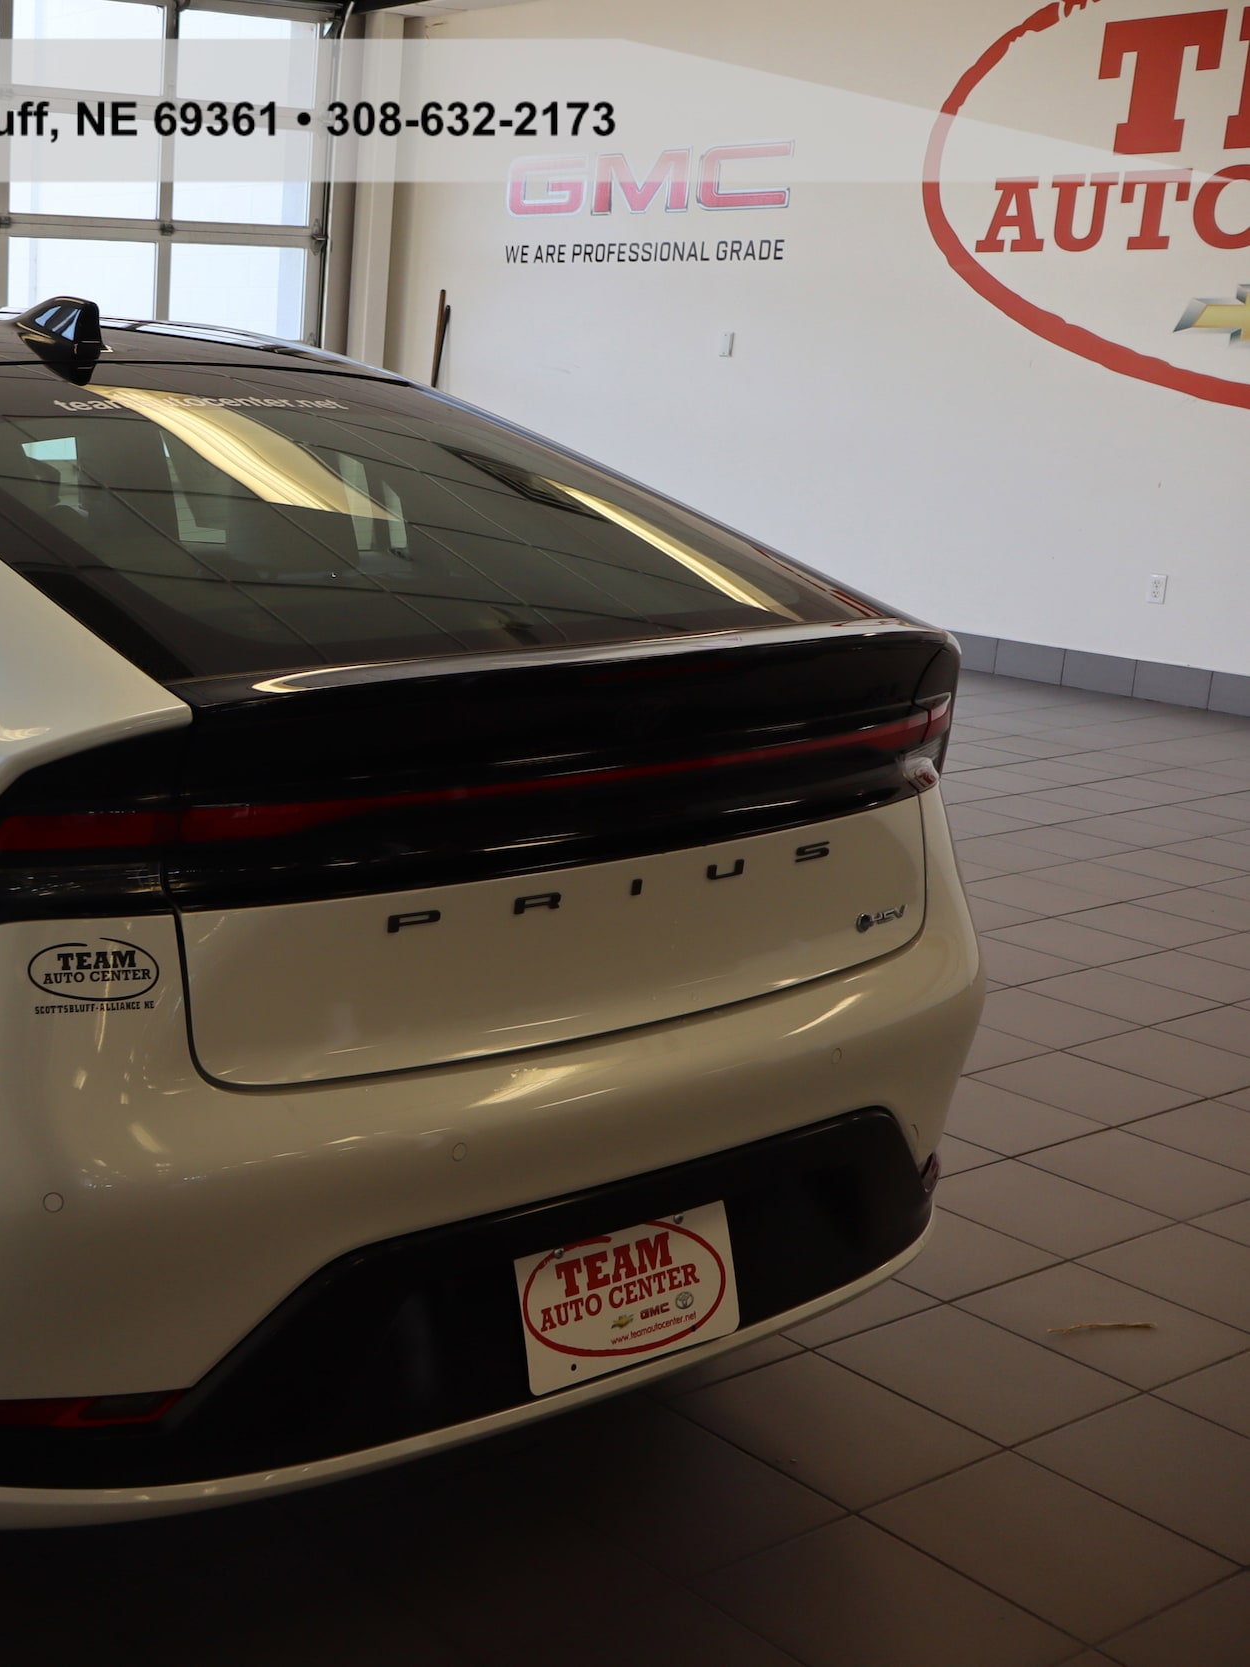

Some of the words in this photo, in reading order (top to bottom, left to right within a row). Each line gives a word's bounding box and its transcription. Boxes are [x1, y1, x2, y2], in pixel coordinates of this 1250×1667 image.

[506, 140, 795, 219] GMC
[505, 244, 530, 264] WE
[533, 243, 566, 263] ARE
[571, 240, 710, 263] PROFESSIONAL
[715, 239, 785, 261] GRADE
[387, 841, 830, 934] PRIUS
[43, 972, 85, 985] AUTO
[90, 969, 152, 983] CENTER
[57, 950, 136, 970] TEAM
[555, 1231, 673, 1298] TEAM
[540, 1293, 602, 1333] AUTO
[608, 1263, 700, 1309] CENTER
[640, 1302, 670, 1320] GMC
[610, 1311, 697, 1345] www.teamautocenter.net
